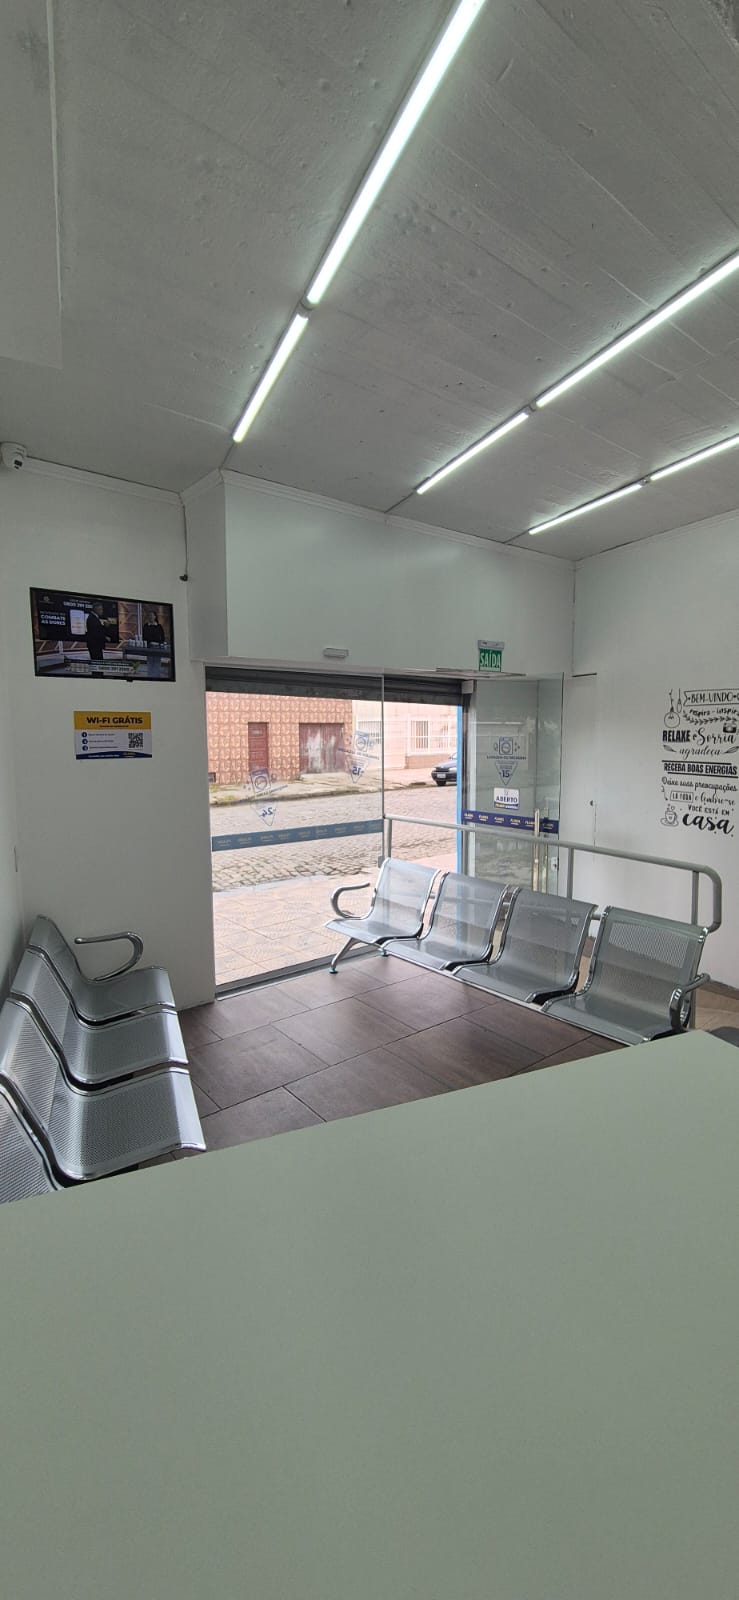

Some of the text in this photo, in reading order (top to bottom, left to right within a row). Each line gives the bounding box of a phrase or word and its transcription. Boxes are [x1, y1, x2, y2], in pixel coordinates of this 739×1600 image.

[480, 651, 501, 667] SAÍDA
[86, 714, 143, 724] WI-FI GRÁTIS
[662, 730, 690, 742] RELAXE
[663, 762, 737, 775] RECEBA BOAS ENERGIAS
[682, 813, 735, 835] casa
